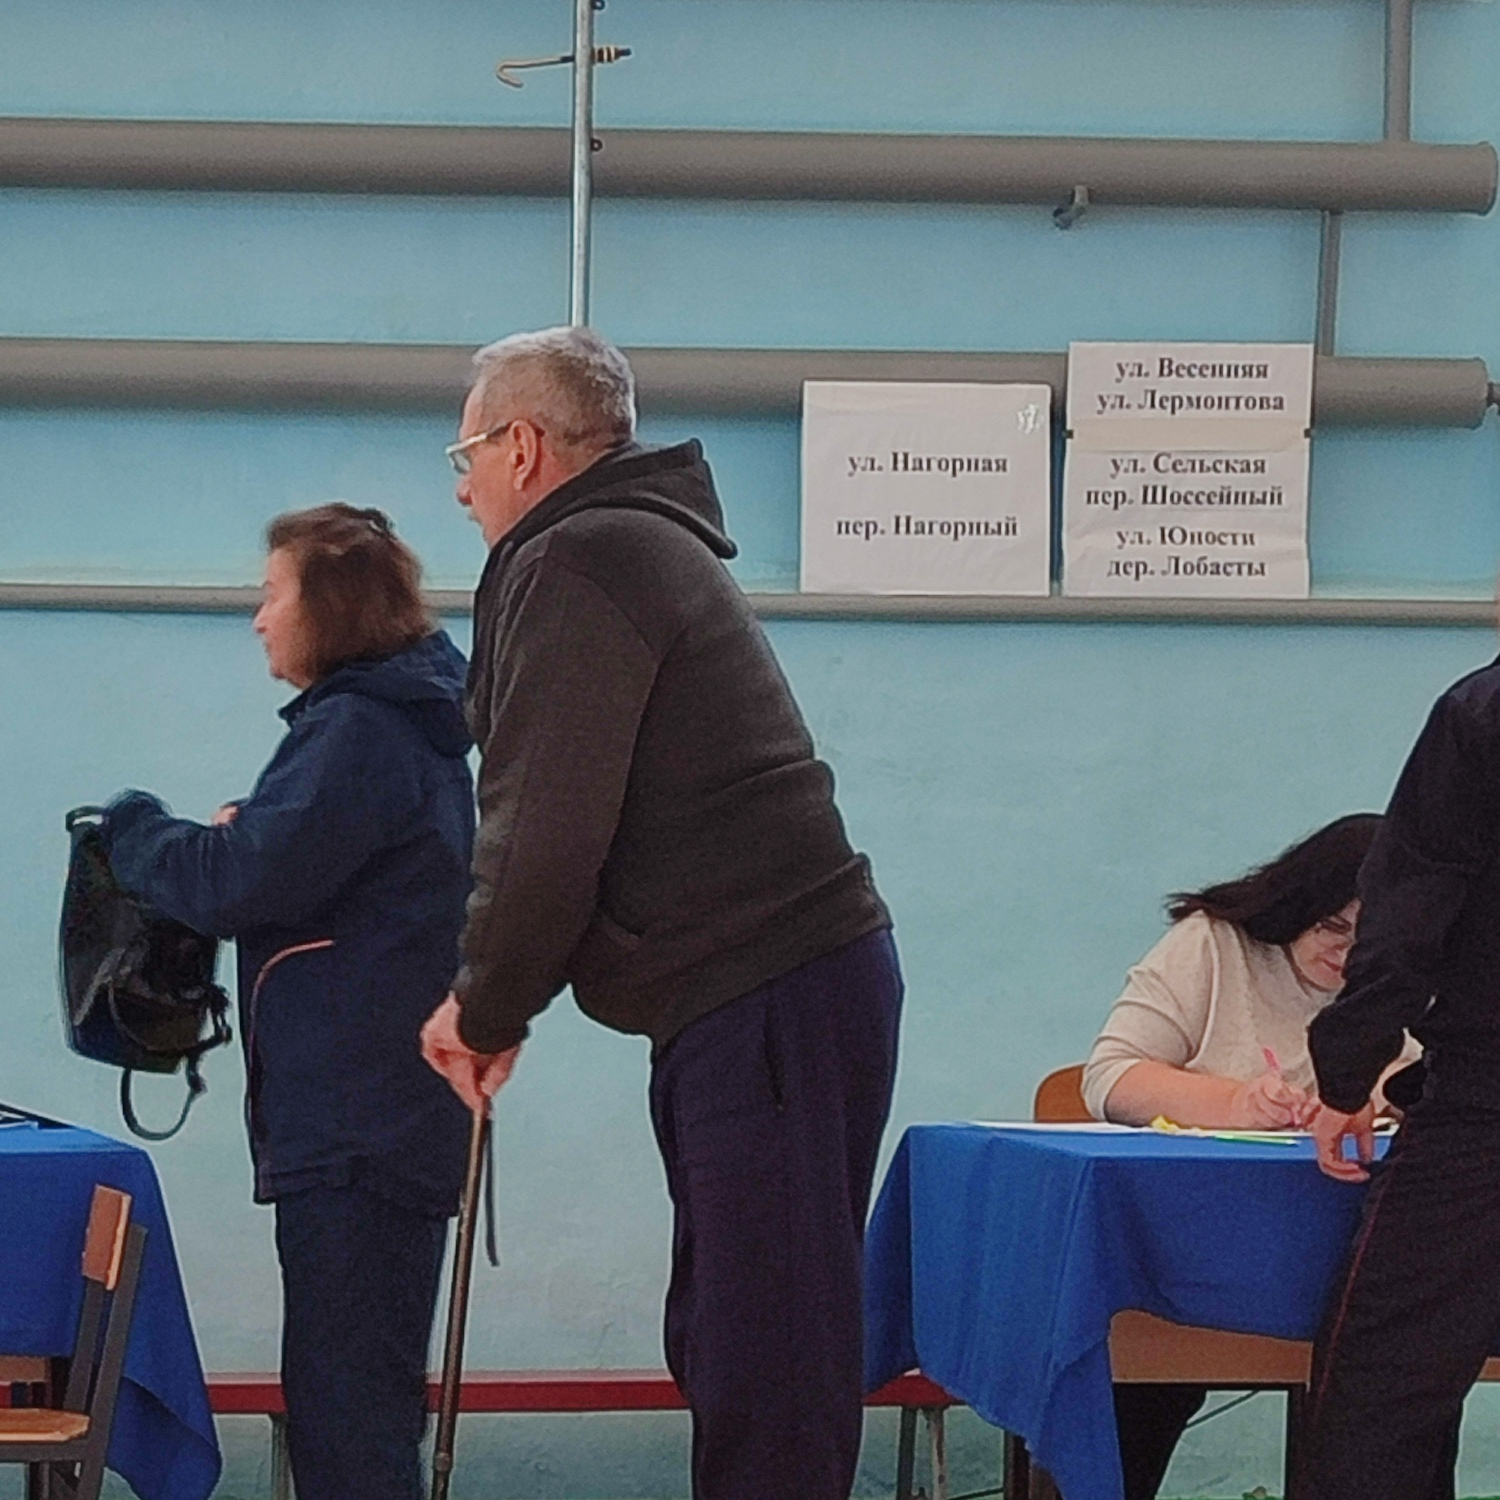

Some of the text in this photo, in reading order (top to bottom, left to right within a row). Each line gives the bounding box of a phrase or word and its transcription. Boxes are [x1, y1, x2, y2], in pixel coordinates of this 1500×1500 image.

[1115, 356, 1269, 383] ул. Весенняя
[1096, 389, 1285, 415] ул. Лермонтова
[847, 451, 1008, 478] ул. Нагорная
[1109, 451, 1266, 480] ул. Сельская
[1085, 484, 1284, 511] пер. Шоссейный
[836, 514, 1018, 542] пер. Нагорный
[1115, 525, 1257, 550] ул. Юности
[1106, 554, 1267, 582] дер. Лобасты
